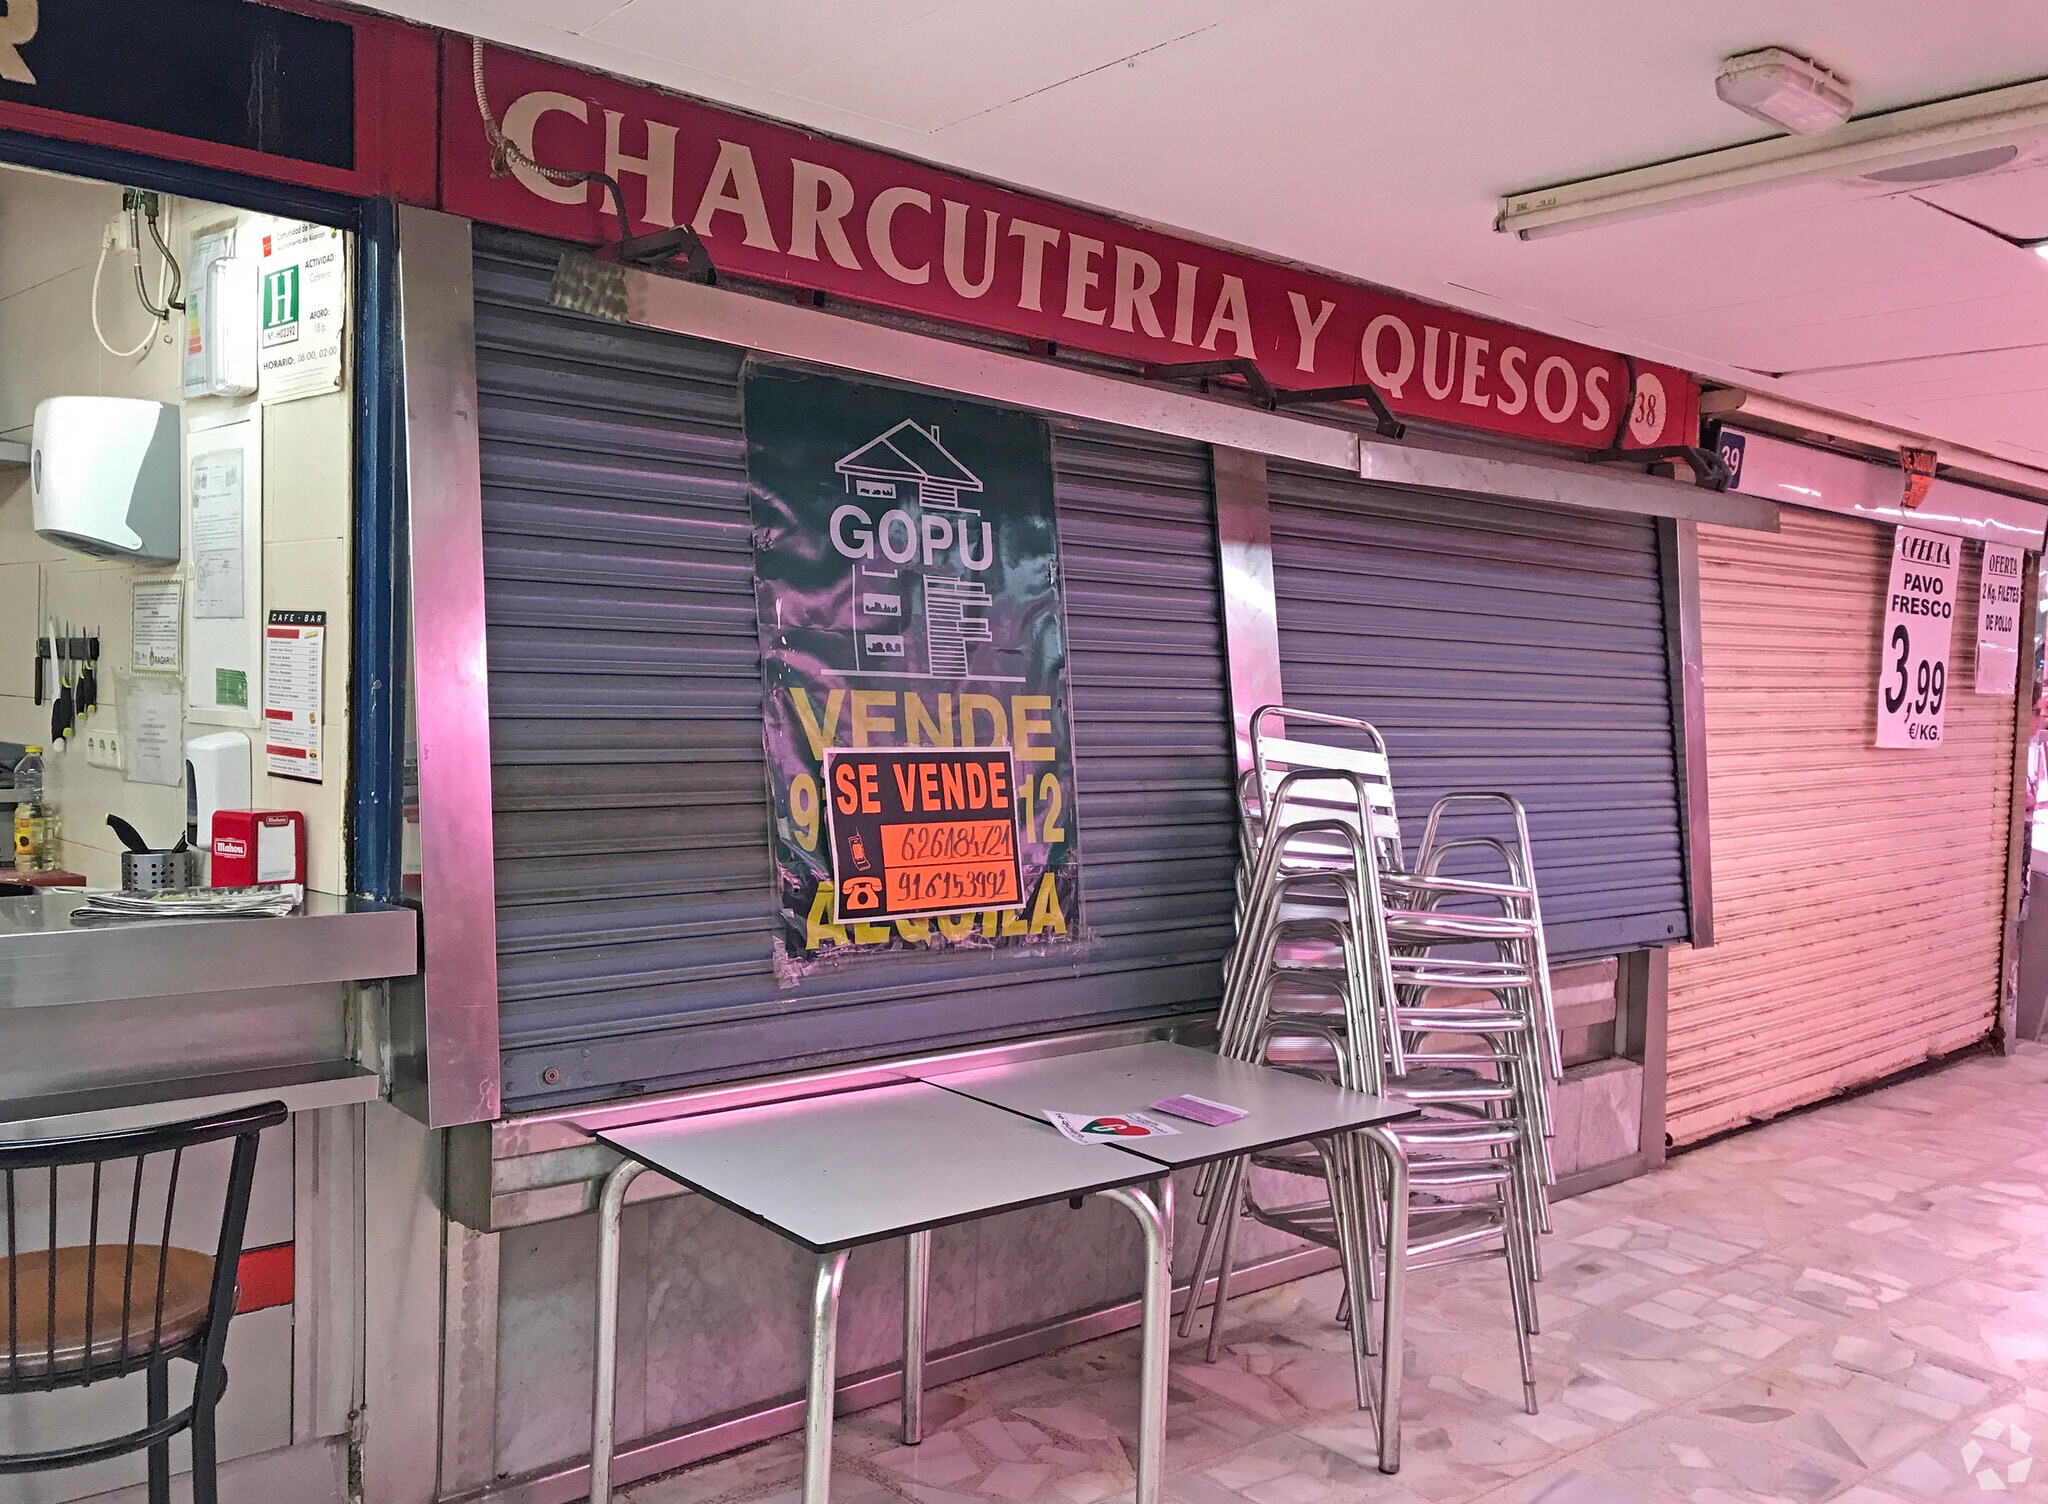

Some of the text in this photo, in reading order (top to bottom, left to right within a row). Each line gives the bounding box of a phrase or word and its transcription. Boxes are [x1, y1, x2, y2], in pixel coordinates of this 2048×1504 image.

[304, 253, 336, 269] ACTIVIDAD:
[501, 90, 1611, 432] CHARCUTERIA Y QUESOS
[268, 269, 294, 326] H
[310, 308, 330, 320] AFORO:
[263, 357, 296, 370] HORARIO:
[318, 345, 338, 358] 02:00
[1635, 392, 1656, 427] 38
[829, 504, 993, 571] GOPU
[1901, 534, 1950, 566] OFERTA
[1989, 554, 2018, 575] OFERTA
[1903, 572, 1944, 595] PAVO
[1982, 583, 1987, 600] 2
[1997, 584, 2020, 604] FILETES
[1891, 594, 1952, 619] FRESCO
[1985, 614, 2013, 633] DE POLLO
[1885, 624, 1945, 724] 3,99
[789, 687, 1056, 761] VENDE
[835, 762, 1009, 815] SE VENDE
[216, 841, 244, 854] Mahou
[901, 824, 1014, 861] 626184721
